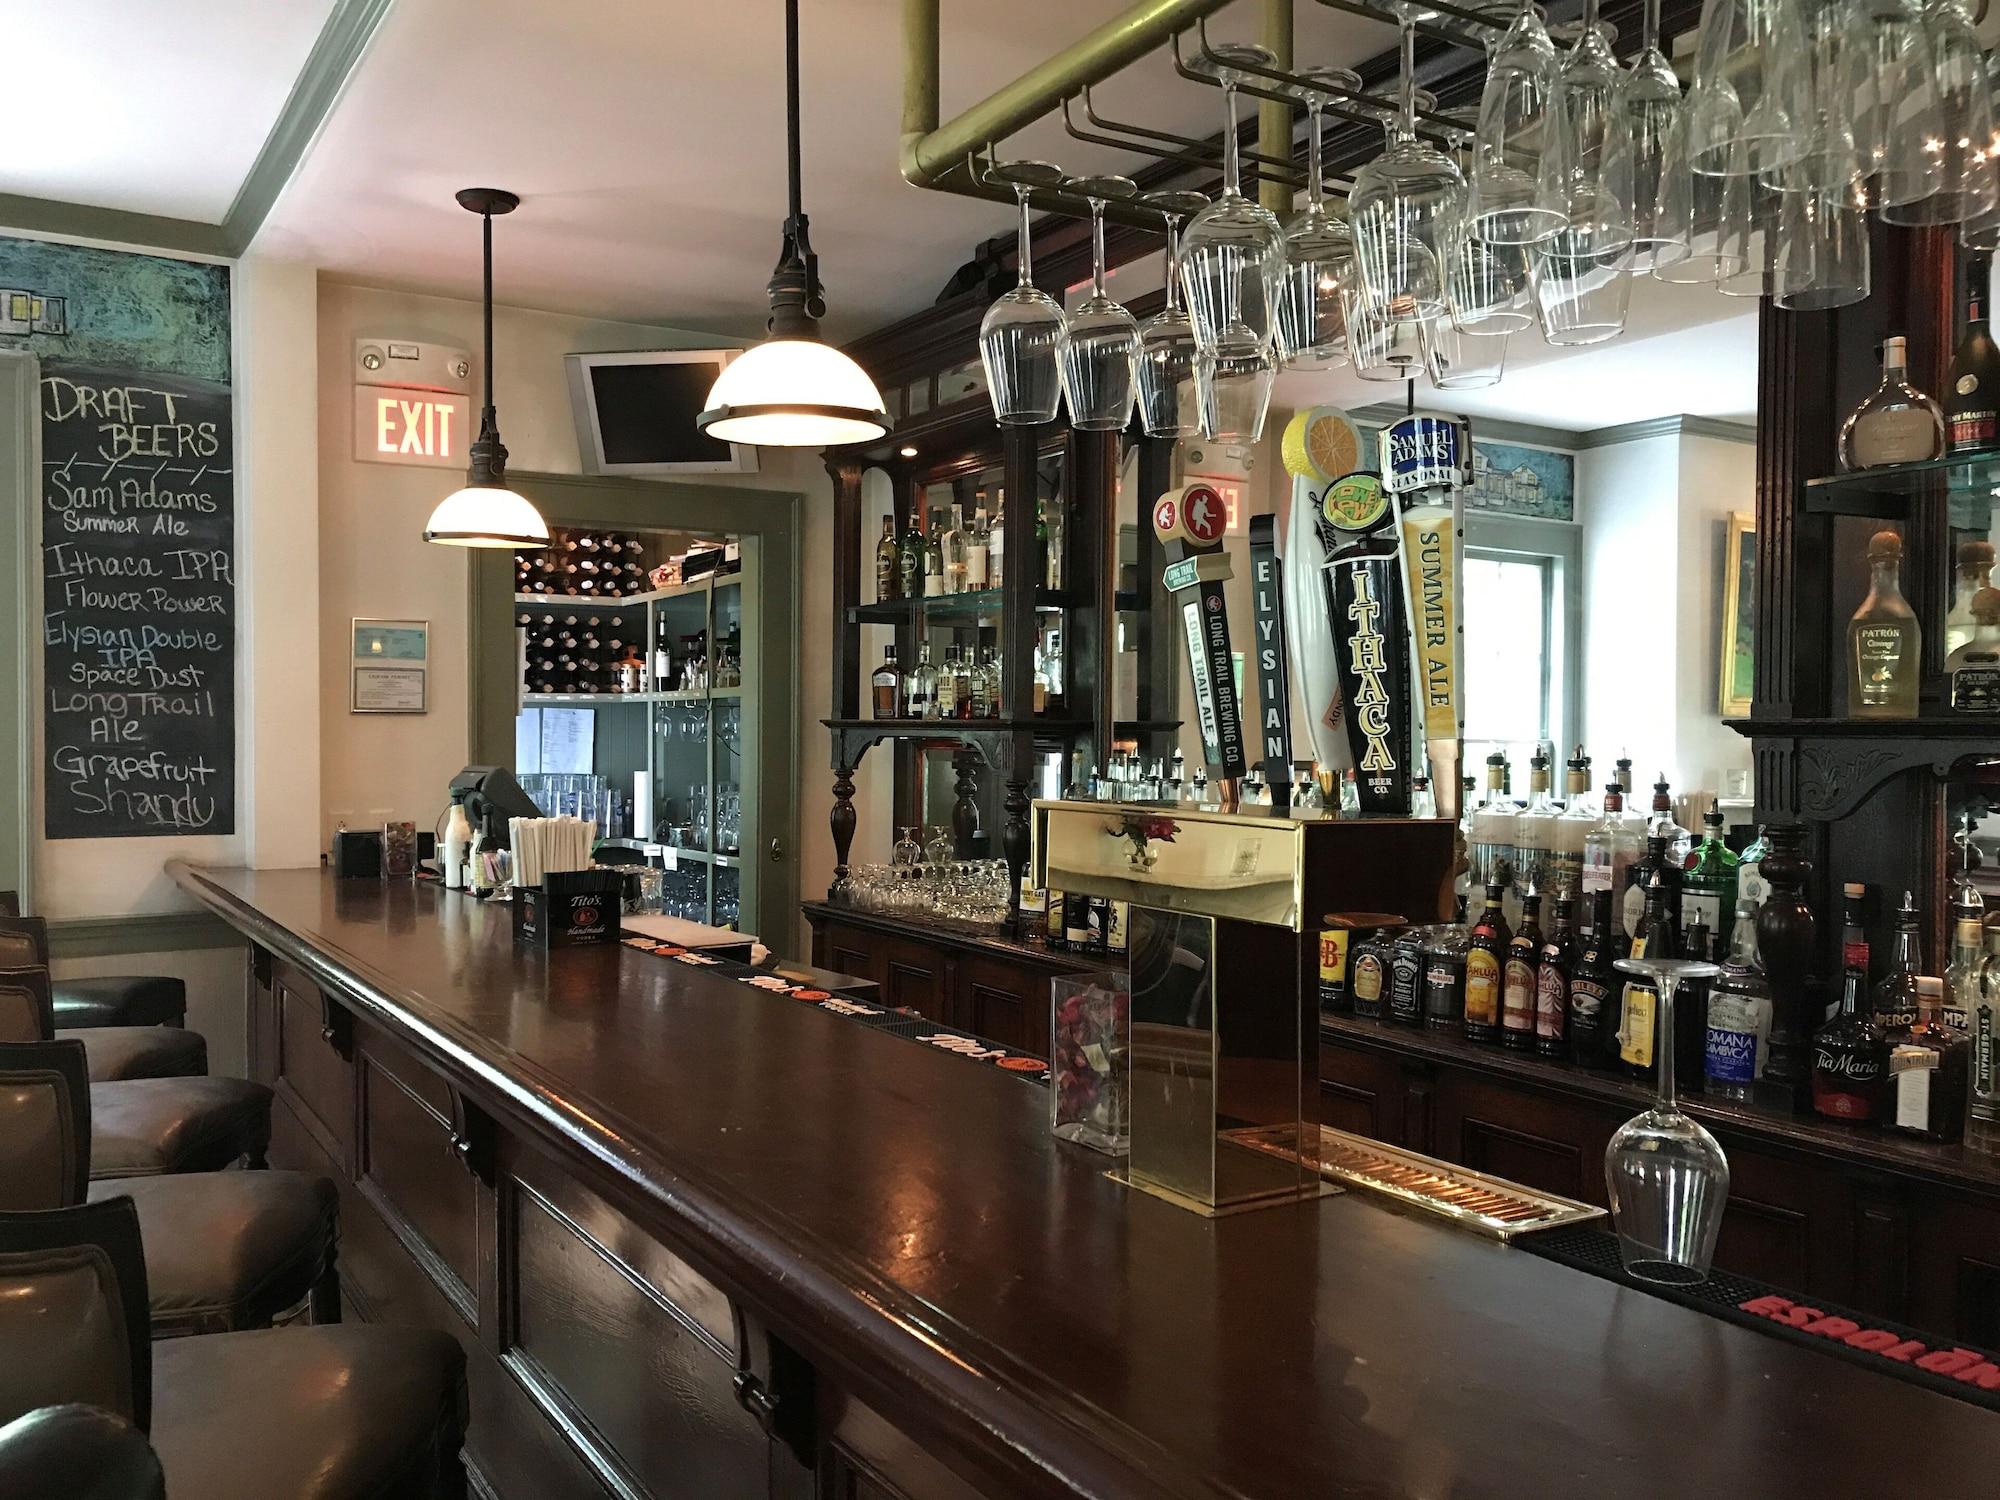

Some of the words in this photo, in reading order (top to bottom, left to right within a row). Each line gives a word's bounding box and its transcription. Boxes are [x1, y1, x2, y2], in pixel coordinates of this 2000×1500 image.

[40, 376, 188, 424] DRAFT
[98, 421, 219, 462] BEERS
[377, 397, 454, 457] EXIT
[1389, 428, 1453, 452] SAMUEL
[1392, 444, 1449, 466] ADAMS
[48, 470, 118, 515] Sam
[119, 478, 218, 513] Adams
[1391, 470, 1452, 489] SEASONAL
[152, 512, 190, 536] Ale
[45, 541, 163, 577] Ithaca
[163, 549, 235, 586] IPA
[1419, 531, 1446, 649] SUMMER
[44, 610, 138, 652] Elysian
[141, 625, 222, 651] Double
[1209, 615, 1225, 647] LONG
[1862, 628, 1900, 638] PATRÓN
[97, 648, 157, 669] IPA
[1211, 649, 1229, 685] TRAIL
[1257, 561, 1283, 758] ELYSIAN
[1348, 570, 1397, 772] ITHACA
[69, 662, 141, 690] Space
[145, 664, 204, 690] Dust
[1193, 658, 1210, 703] TRAIL
[1426, 657, 1451, 707] ALE
[52, 688, 128, 719] Long
[1217, 687, 1237, 743] BREWING
[90, 715, 143, 743] Ale
[1201, 705, 1215, 734] ALE
[53, 745, 217, 785] Grapefruit
[1226, 745, 1239, 767] CO.
[1367, 777, 1393, 787] BEER
[1373, 786, 1389, 794] CO.
[70, 777, 215, 828] Shandy
[570, 894, 602, 907] Tito's
[1706, 1029, 1753, 1049] OMANA
[1815, 1047, 1833, 1069] Tia
[1831, 1054, 1880, 1075] Maria
